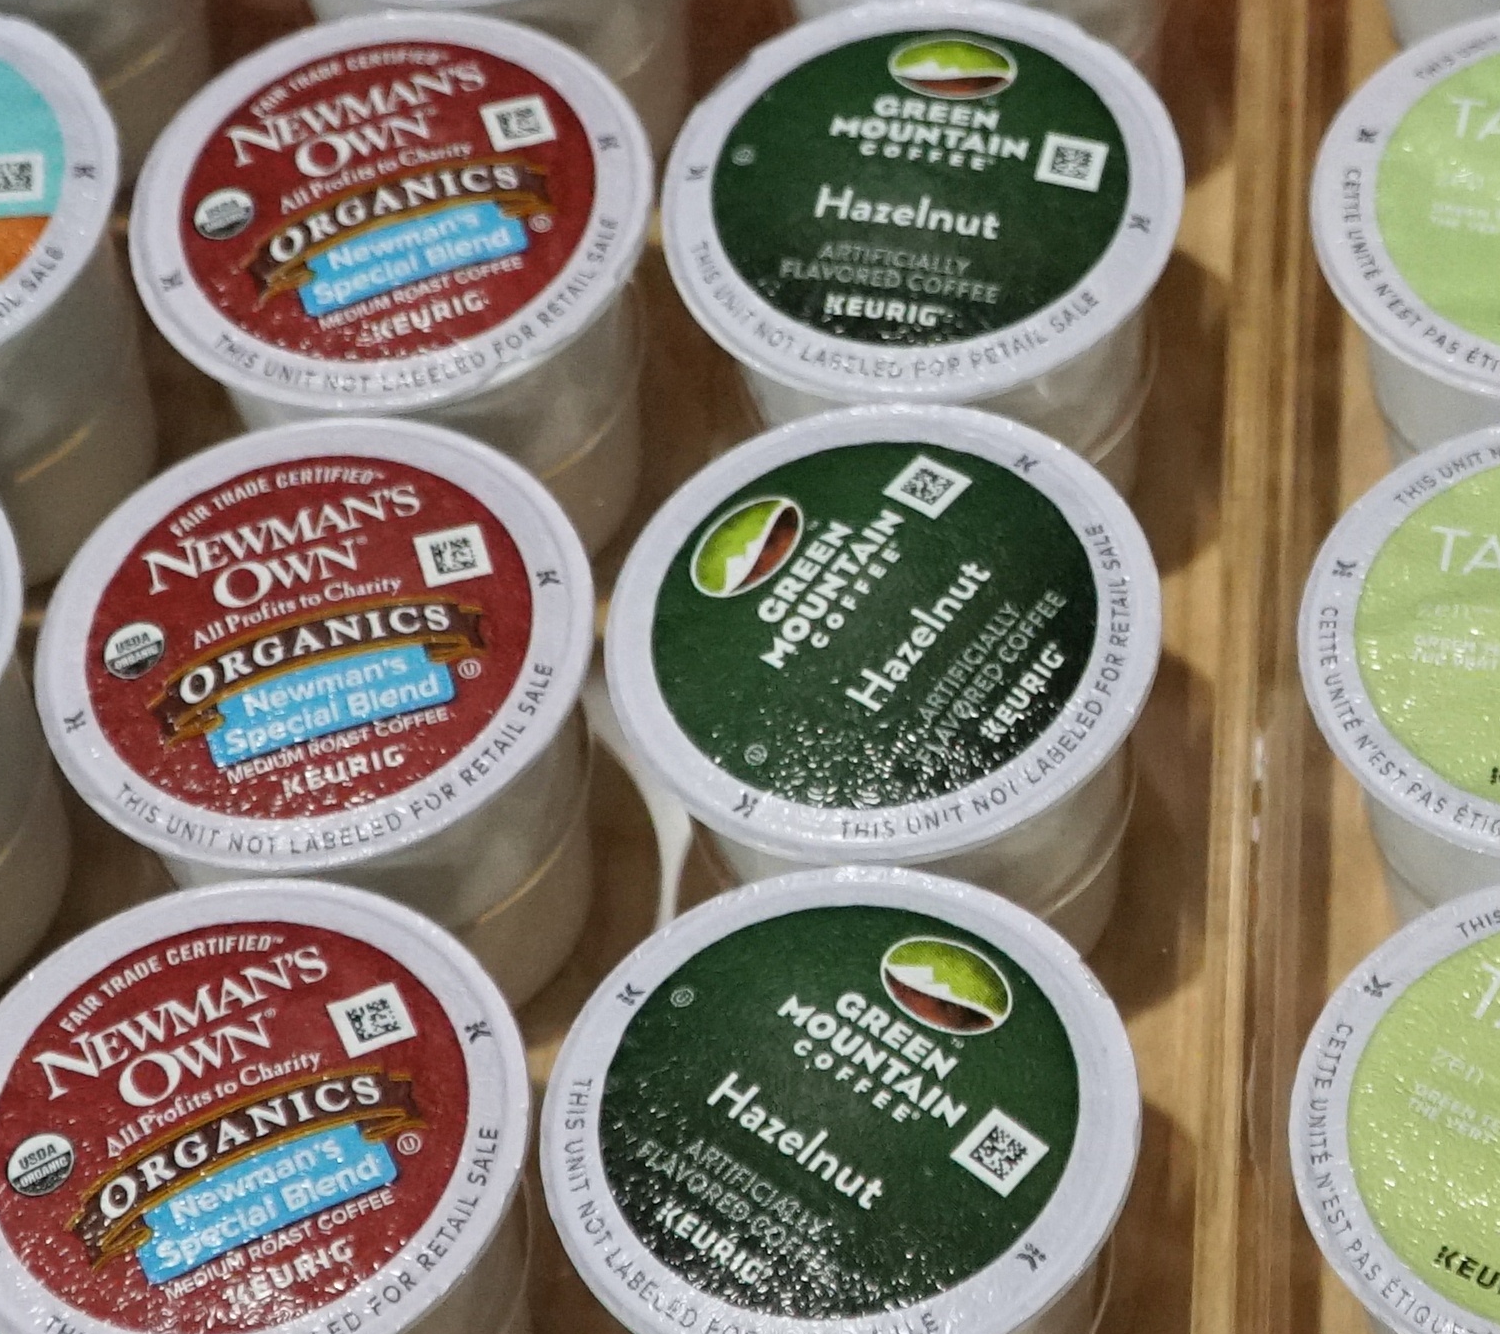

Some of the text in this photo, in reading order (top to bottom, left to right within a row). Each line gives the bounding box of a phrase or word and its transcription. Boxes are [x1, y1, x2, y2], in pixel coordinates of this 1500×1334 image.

[228, 65, 487, 170] NEWMAN'S
[828, 117, 1029, 161] MOUNTAIN
[872, 94, 1001, 130] GREEN
[268, 162, 521, 263] ORGANICS
[813, 183, 1001, 243] Hazelnut
[142, 484, 421, 596] NEWMAN'S
[212, 537, 360, 608] OWN
[755, 521, 852, 622] GREEN
[761, 507, 907, 673] MOUNTAIN
[178, 599, 450, 705] ORGANICS
[846, 562, 991, 714] Hazelnut
[30, 942, 332, 1103] NEWMAN'S
[60, 936, 275, 1034] FAIR TRADE CERTIFIED
[835, 989, 957, 1080] GREEN
[117, 1010, 270, 1111] OWN
[777, 993, 967, 1129] MOUNTAIN
[99, 1074, 385, 1221] ORGANICS
[168, 1139, 345, 1231] Newman's
[705, 1070, 889, 1213] Hazelnut
[154, 1152, 381, 1272] Special Blend
